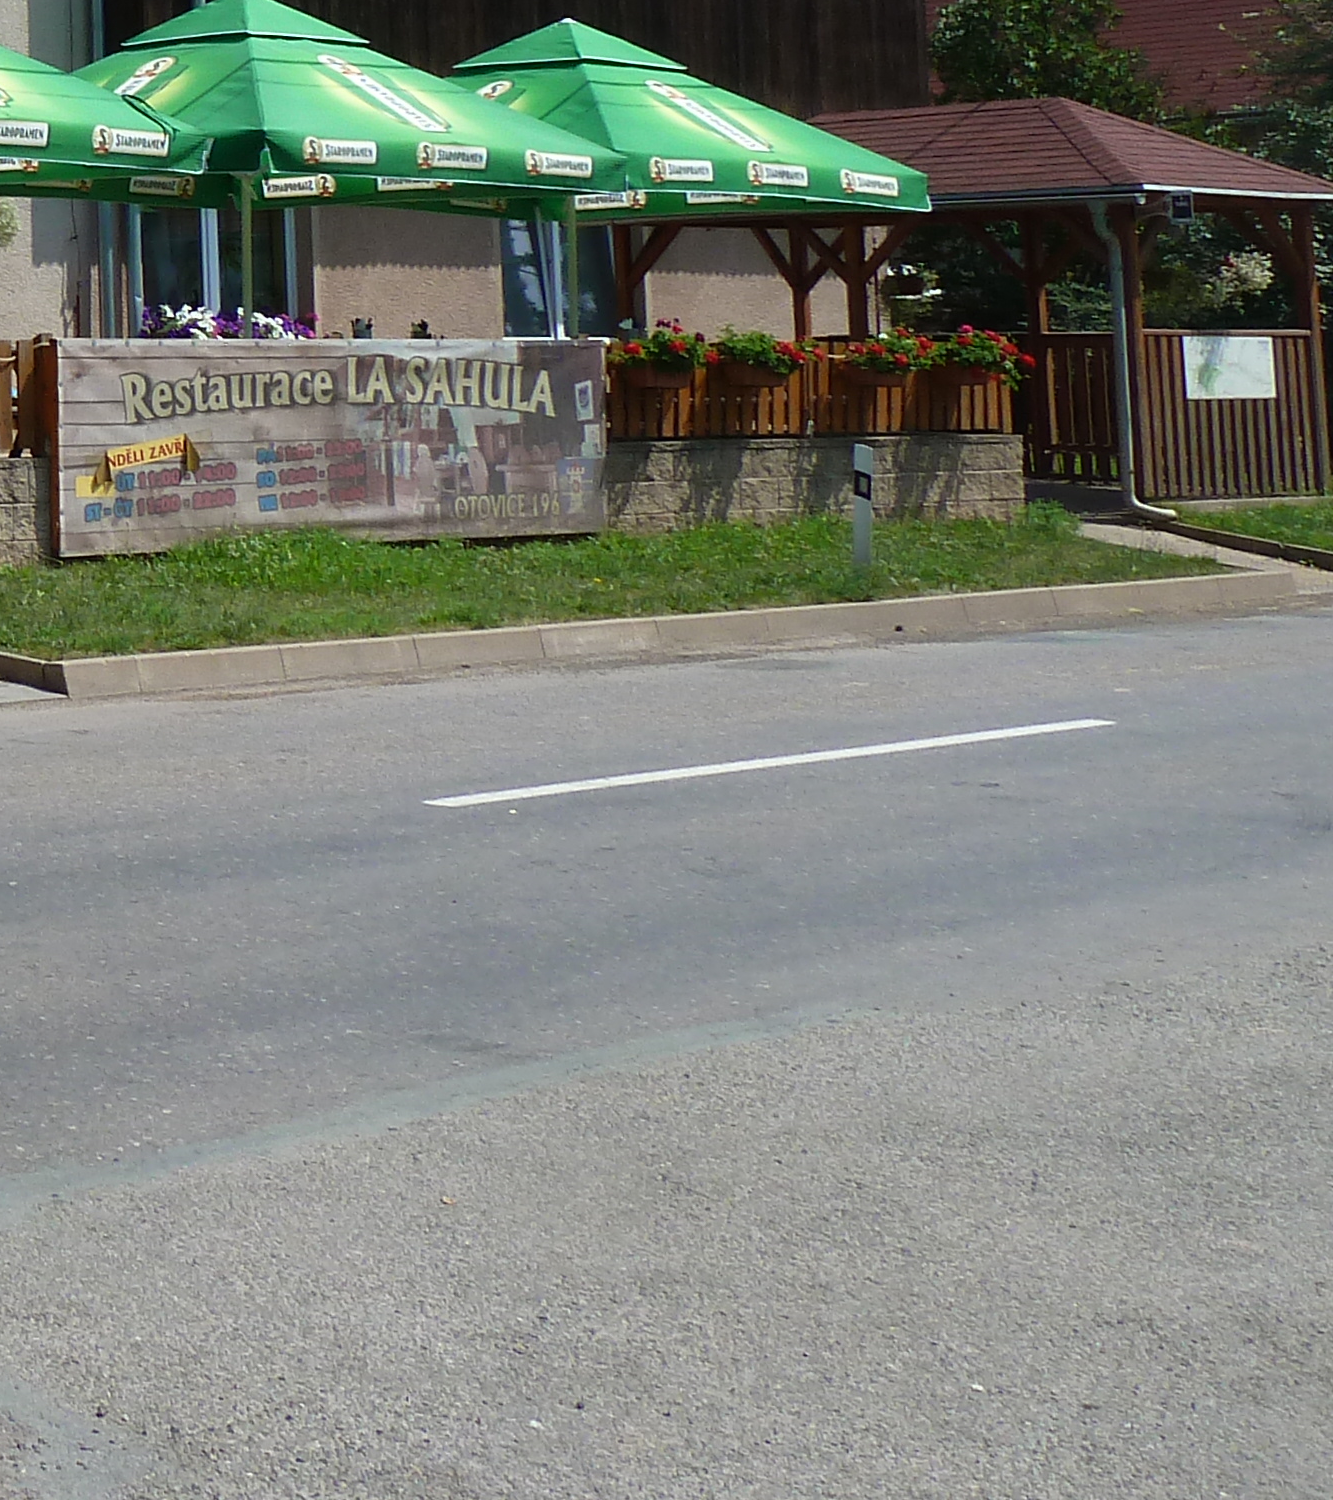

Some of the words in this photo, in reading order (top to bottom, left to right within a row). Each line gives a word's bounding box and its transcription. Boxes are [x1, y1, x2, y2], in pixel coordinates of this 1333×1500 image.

[119, 366, 334, 424] Restaurace
[346, 354, 395, 404] LA
[405, 355, 557, 418] SAHULA
[454, 493, 525, 520] OTOVICE
[533, 492, 560, 517] 196
